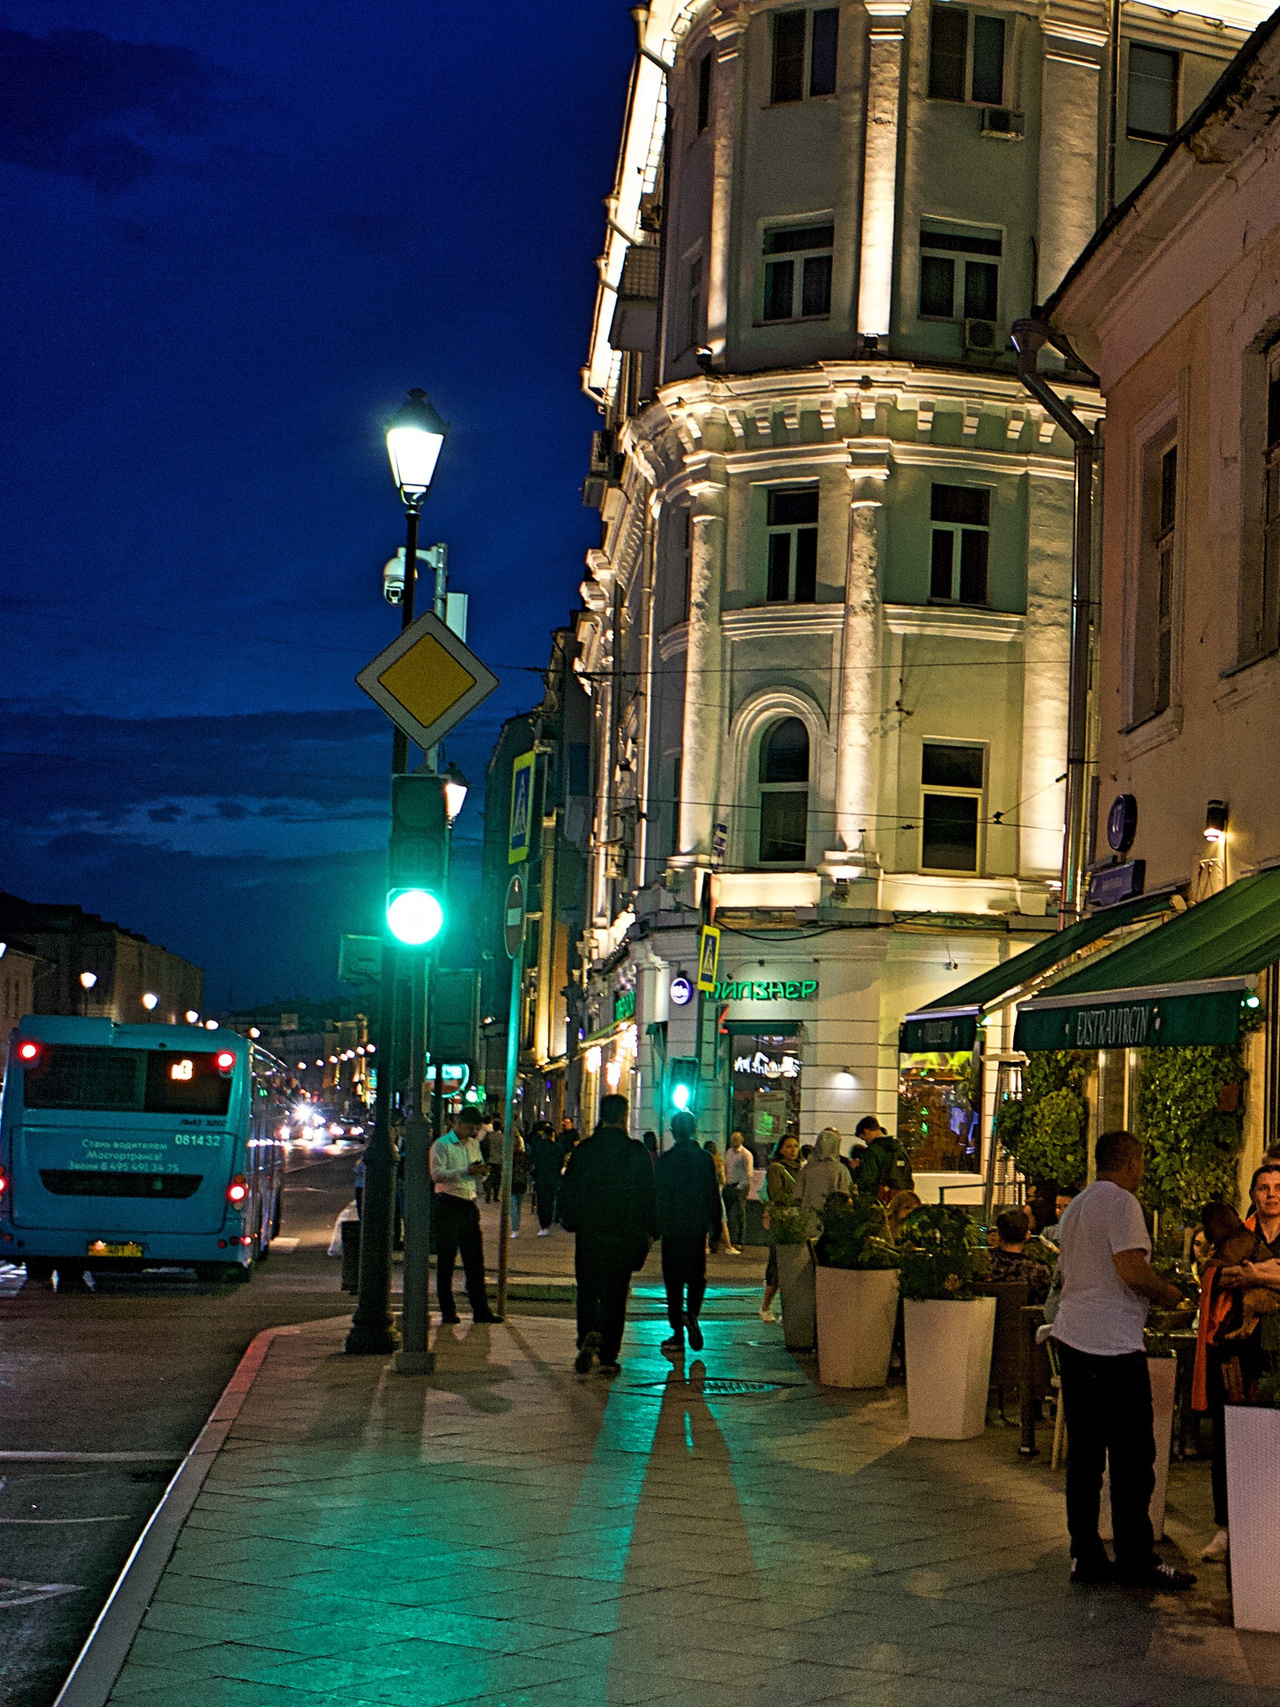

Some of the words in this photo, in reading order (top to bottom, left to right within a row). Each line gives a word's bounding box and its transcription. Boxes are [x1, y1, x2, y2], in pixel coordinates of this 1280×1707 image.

[81, 1138, 111, 1149] Стань
[112, 1141, 168, 1150] водителем
[174, 1133, 221, 1147] 081432
[109, 1162, 129, 1171] 495
